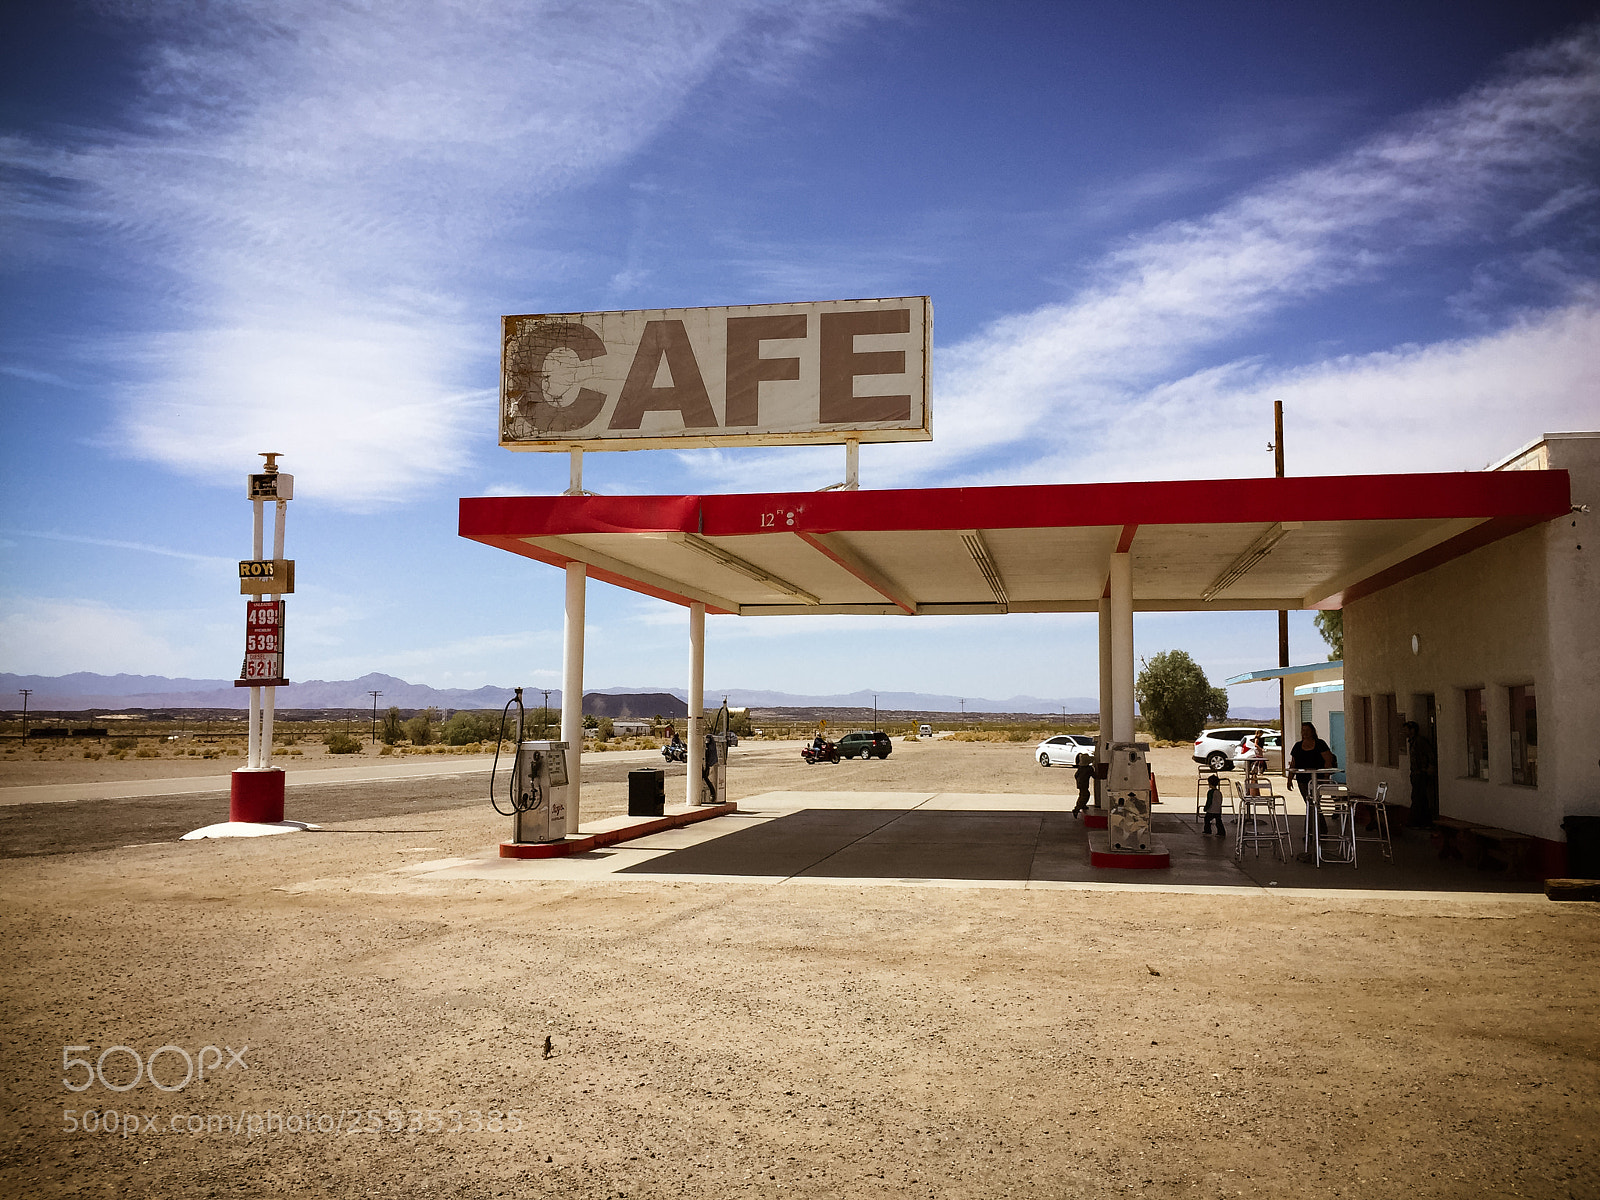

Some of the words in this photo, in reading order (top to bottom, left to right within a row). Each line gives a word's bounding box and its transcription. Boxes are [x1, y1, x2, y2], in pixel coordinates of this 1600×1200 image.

[508, 309, 911, 432] CAFE
[760, 513, 775, 527] 12
[247, 660, 272, 677] 521
